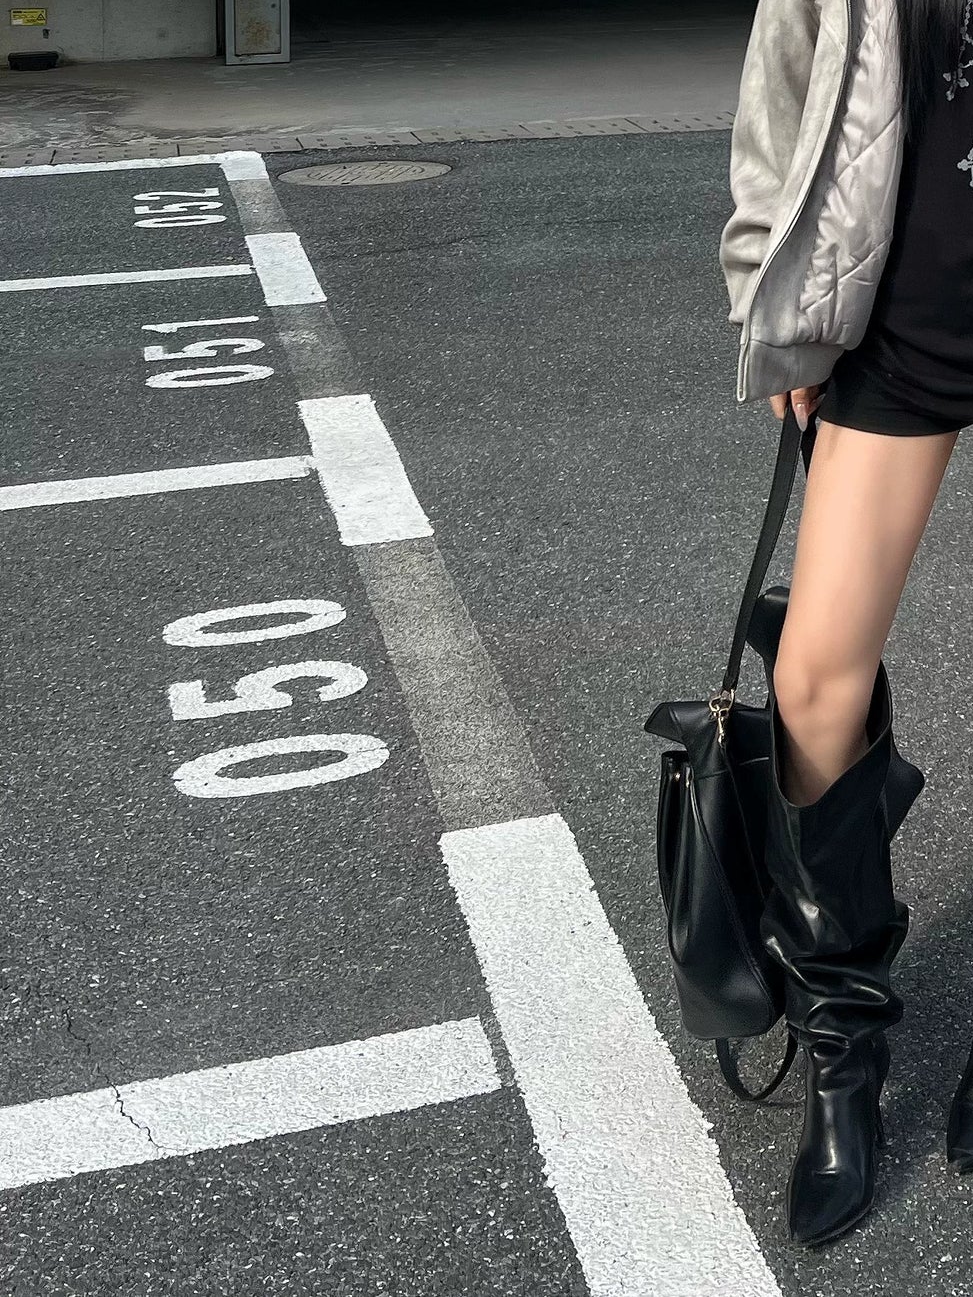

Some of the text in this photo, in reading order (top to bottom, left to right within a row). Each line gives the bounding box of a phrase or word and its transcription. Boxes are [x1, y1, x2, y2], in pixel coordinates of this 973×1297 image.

[133, 186, 227, 229] 052
[141, 315, 275, 390] 051
[162, 599, 391, 799] 050
